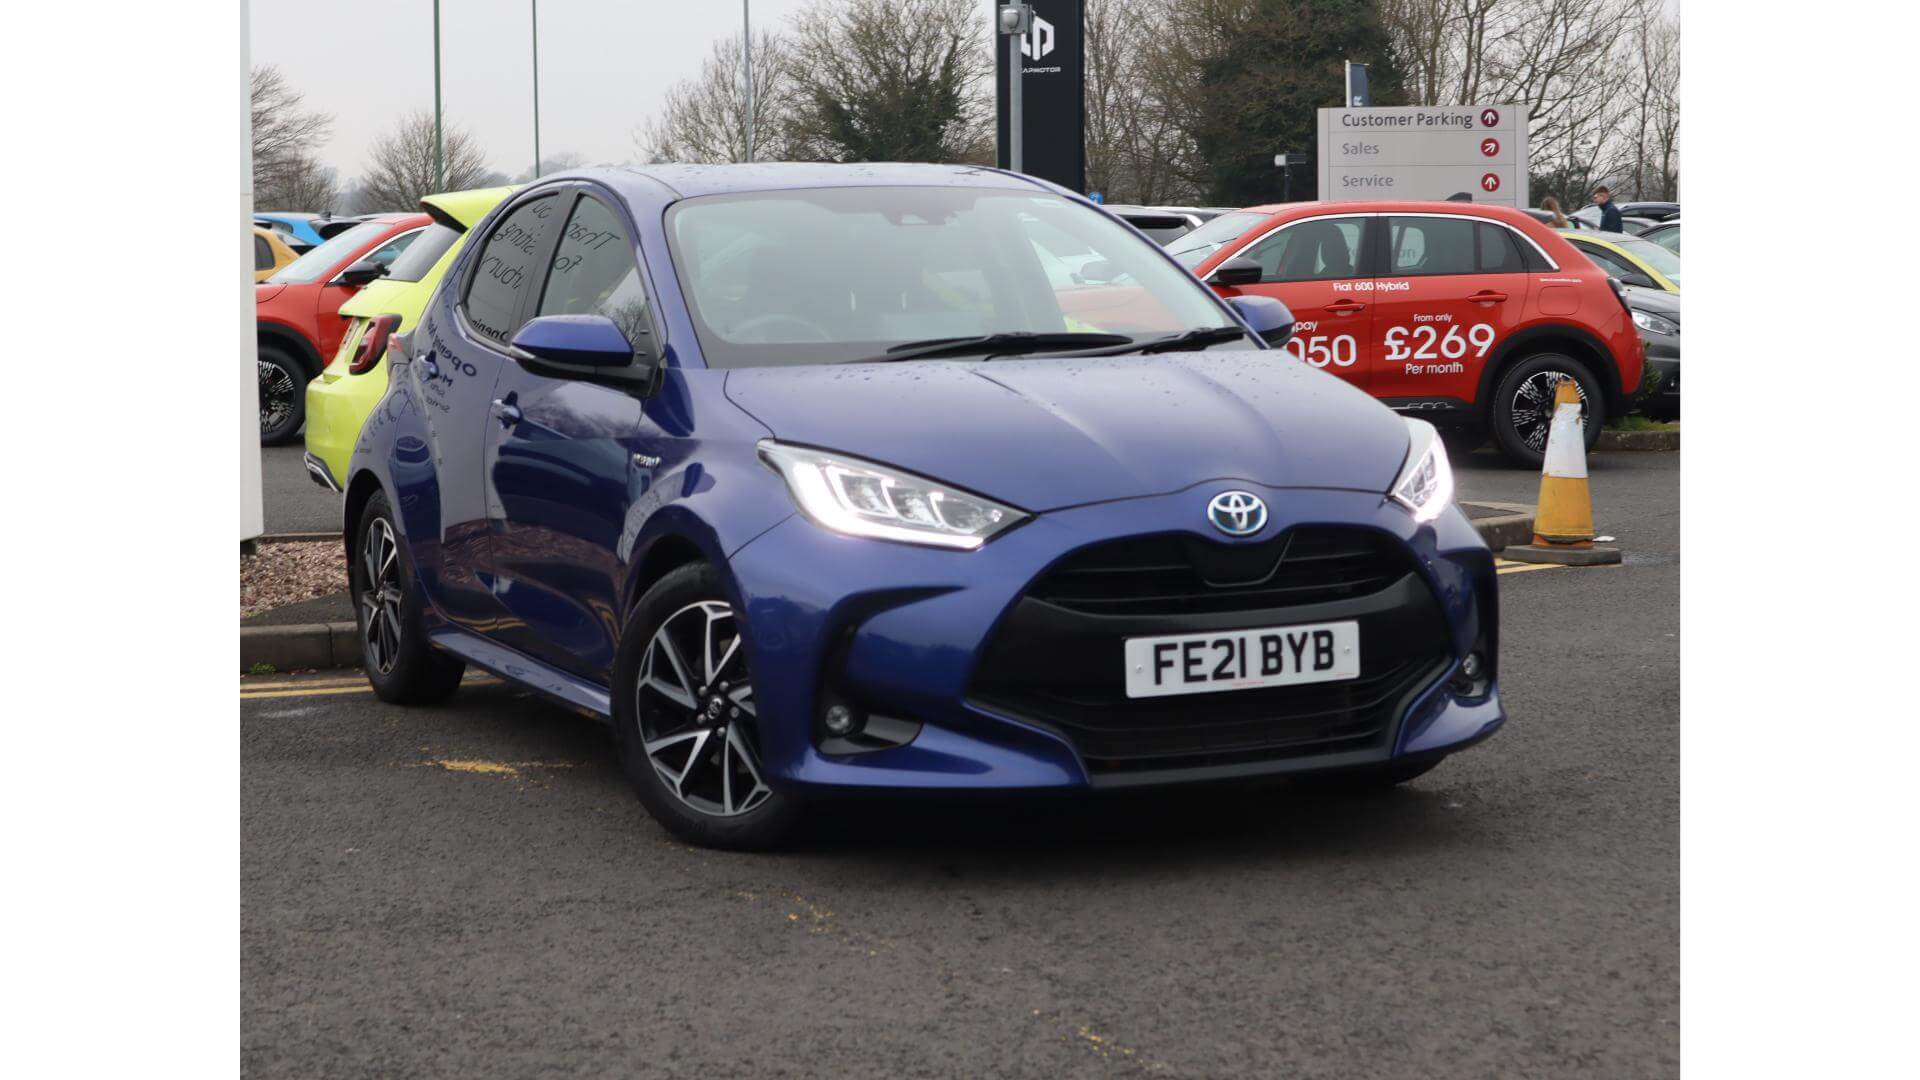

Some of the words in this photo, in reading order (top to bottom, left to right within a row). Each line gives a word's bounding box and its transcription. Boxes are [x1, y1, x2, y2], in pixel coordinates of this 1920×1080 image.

[1022, 66, 1061, 74] APMOTOR
[1342, 113, 1412, 127] Customer
[1417, 112, 1473, 129] Parking
[1342, 142, 1380, 155] Sales
[1342, 174, 1394, 187] Service
[1333, 282, 1352, 292] Fiat
[1355, 281, 1374, 291] 600
[1376, 280, 1410, 292] Hybrid
[1413, 314, 1433, 322] From
[1435, 313, 1453, 323] only
[1295, 321, 1318, 333] pay
[1384, 323, 1496, 361] £269
[1405, 363, 1424, 375] Per
[1426, 362, 1464, 374] month
[1153, 637, 1246, 686] FE21
[1260, 630, 1335, 676] BYB
